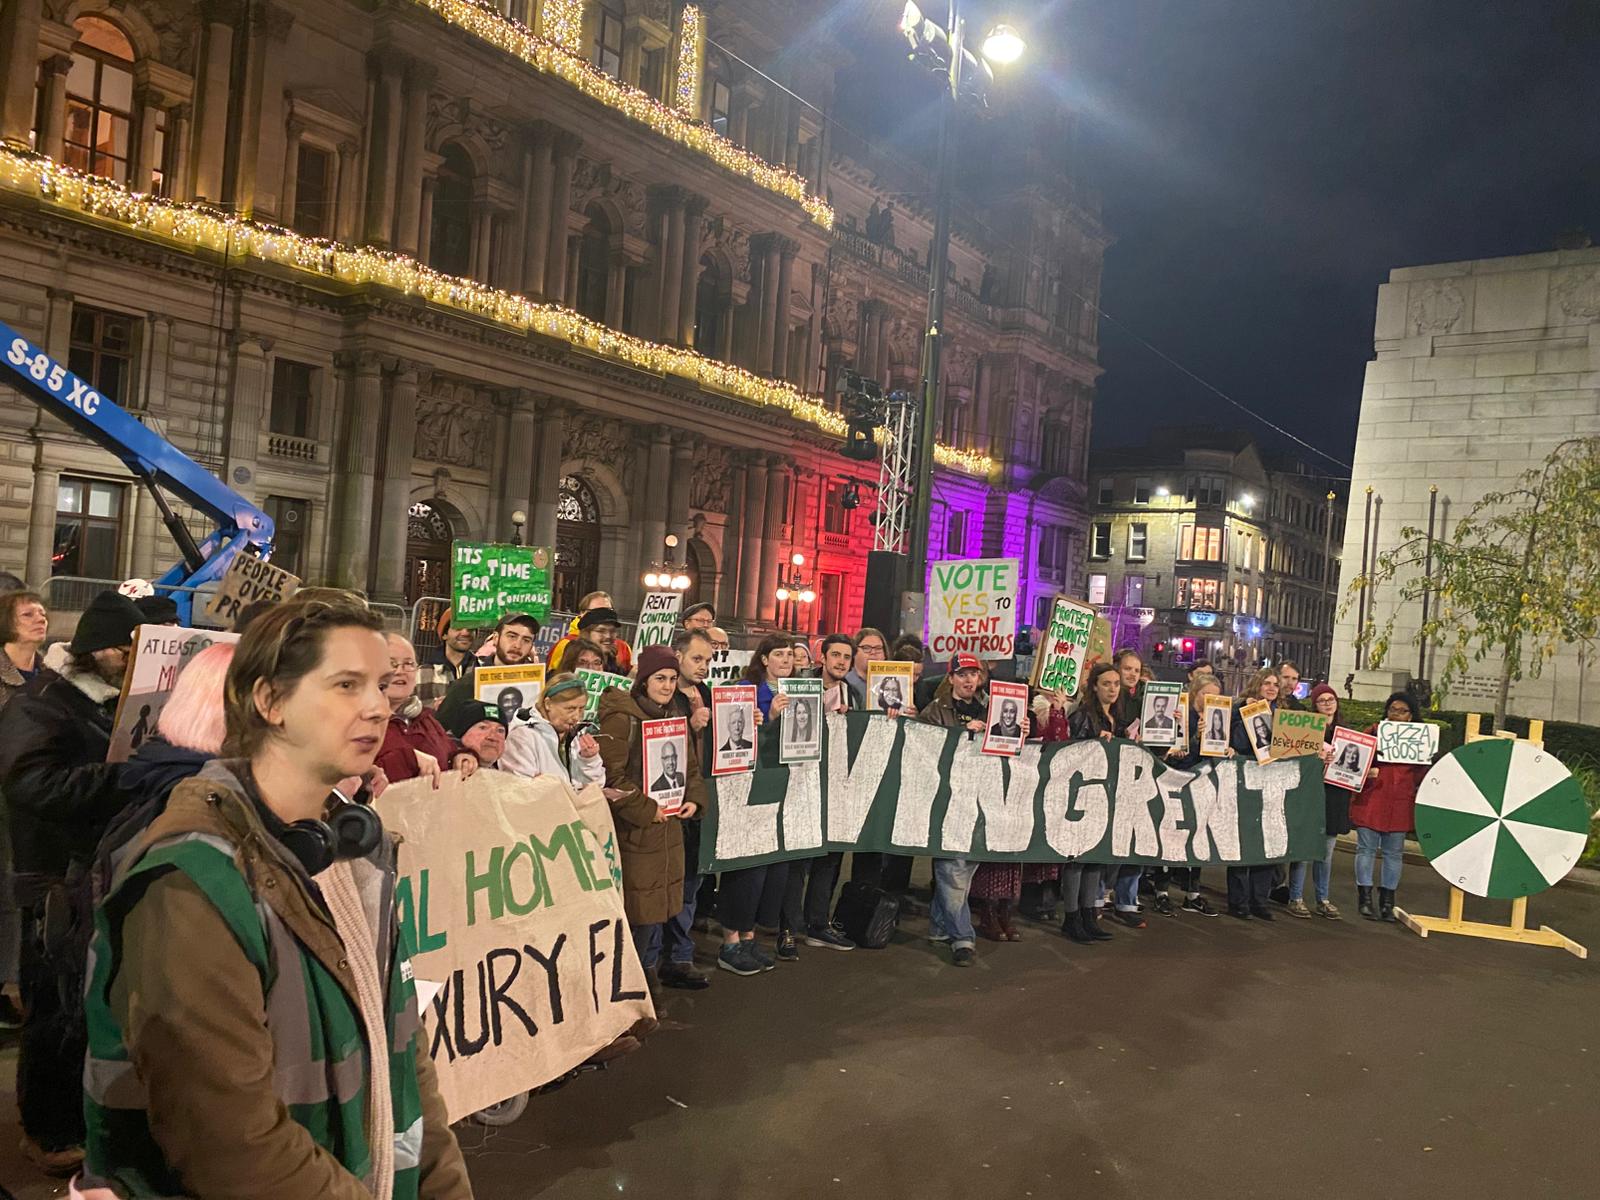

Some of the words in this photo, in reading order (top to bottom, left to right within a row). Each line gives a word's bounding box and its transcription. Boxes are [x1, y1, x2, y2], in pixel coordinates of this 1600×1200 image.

[7, 338, 67, 391] S-85
[65, 377, 100, 416] XC
[457, 547, 483, 564] ITS
[233, 554, 288, 591] PEOPLE
[462, 573, 490, 591] FOR
[936, 563, 1009, 592] VOTE
[215, 595, 241, 620] PR
[458, 595, 495, 613] RENT
[645, 594, 677, 610] RENT
[942, 592, 989, 618] YES
[995, 596, 1011, 610] TO
[641, 612, 678, 625] CONTROLS
[953, 616, 1001, 635] RENT
[1055, 604, 1094, 630] PROTECT
[143, 639, 160, 654] AT
[162, 639, 197, 656] LEAST
[637, 625, 674, 650] NOW
[933, 634, 1013, 655] CONTROLS
[712, 650, 729, 662] NT
[1046, 653, 1077, 676] LAND
[157, 665, 177, 692] MI
[1279, 711, 1326, 731] PEOPLE
[1273, 737, 1320, 751] DEVELOPERS
[396, 869, 447, 957] AL
[428, 933, 567, 1064] XURY
[589, 918, 646, 1014] FL
